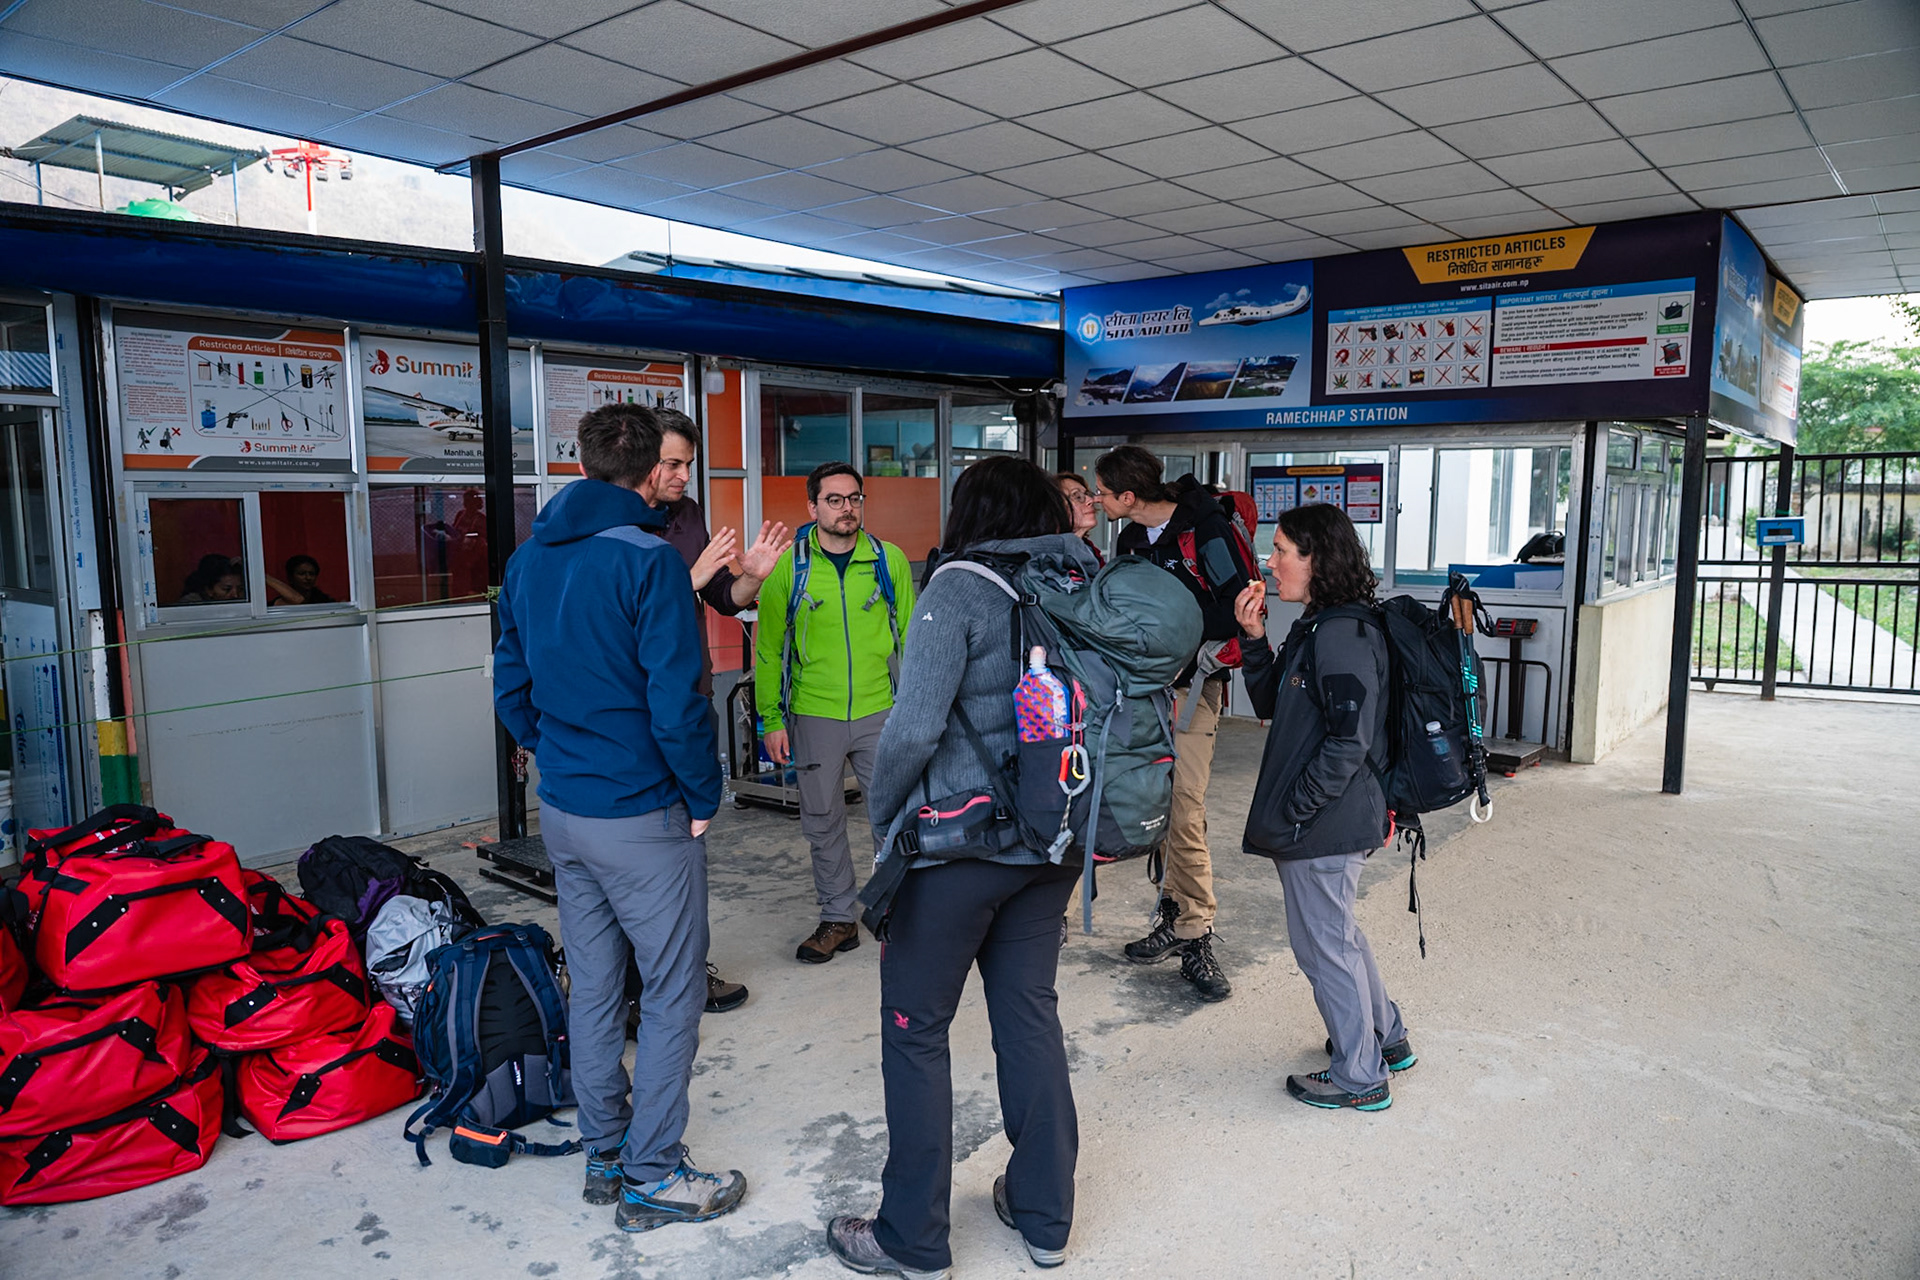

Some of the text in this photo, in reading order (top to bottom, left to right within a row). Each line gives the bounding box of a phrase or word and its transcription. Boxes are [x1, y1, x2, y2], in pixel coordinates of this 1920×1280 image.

[1427, 236, 1566, 263] RESTRICTED ARTICLES
[1460, 279, 1529, 292] www.sitaair.com.np
[1499, 295, 1533, 304] IMPORTANT
[1106, 313, 1138, 327] सीता
[1142, 311, 1171, 324] एयर
[1107, 329, 1134, 339] SITA
[1139, 326, 1162, 336] AIR
[199, 339, 242, 351] Restricted
[245, 343, 276, 354] Articles
[395, 355, 474, 378] Summit
[593, 372, 621, 381] Restricted
[622, 374, 642, 382] Articles
[1266, 406, 1408, 425] RAMECHHAP STATION
[254, 442, 316, 453] Summit Air
[238, 460, 320, 468] www.summitair.com.np
